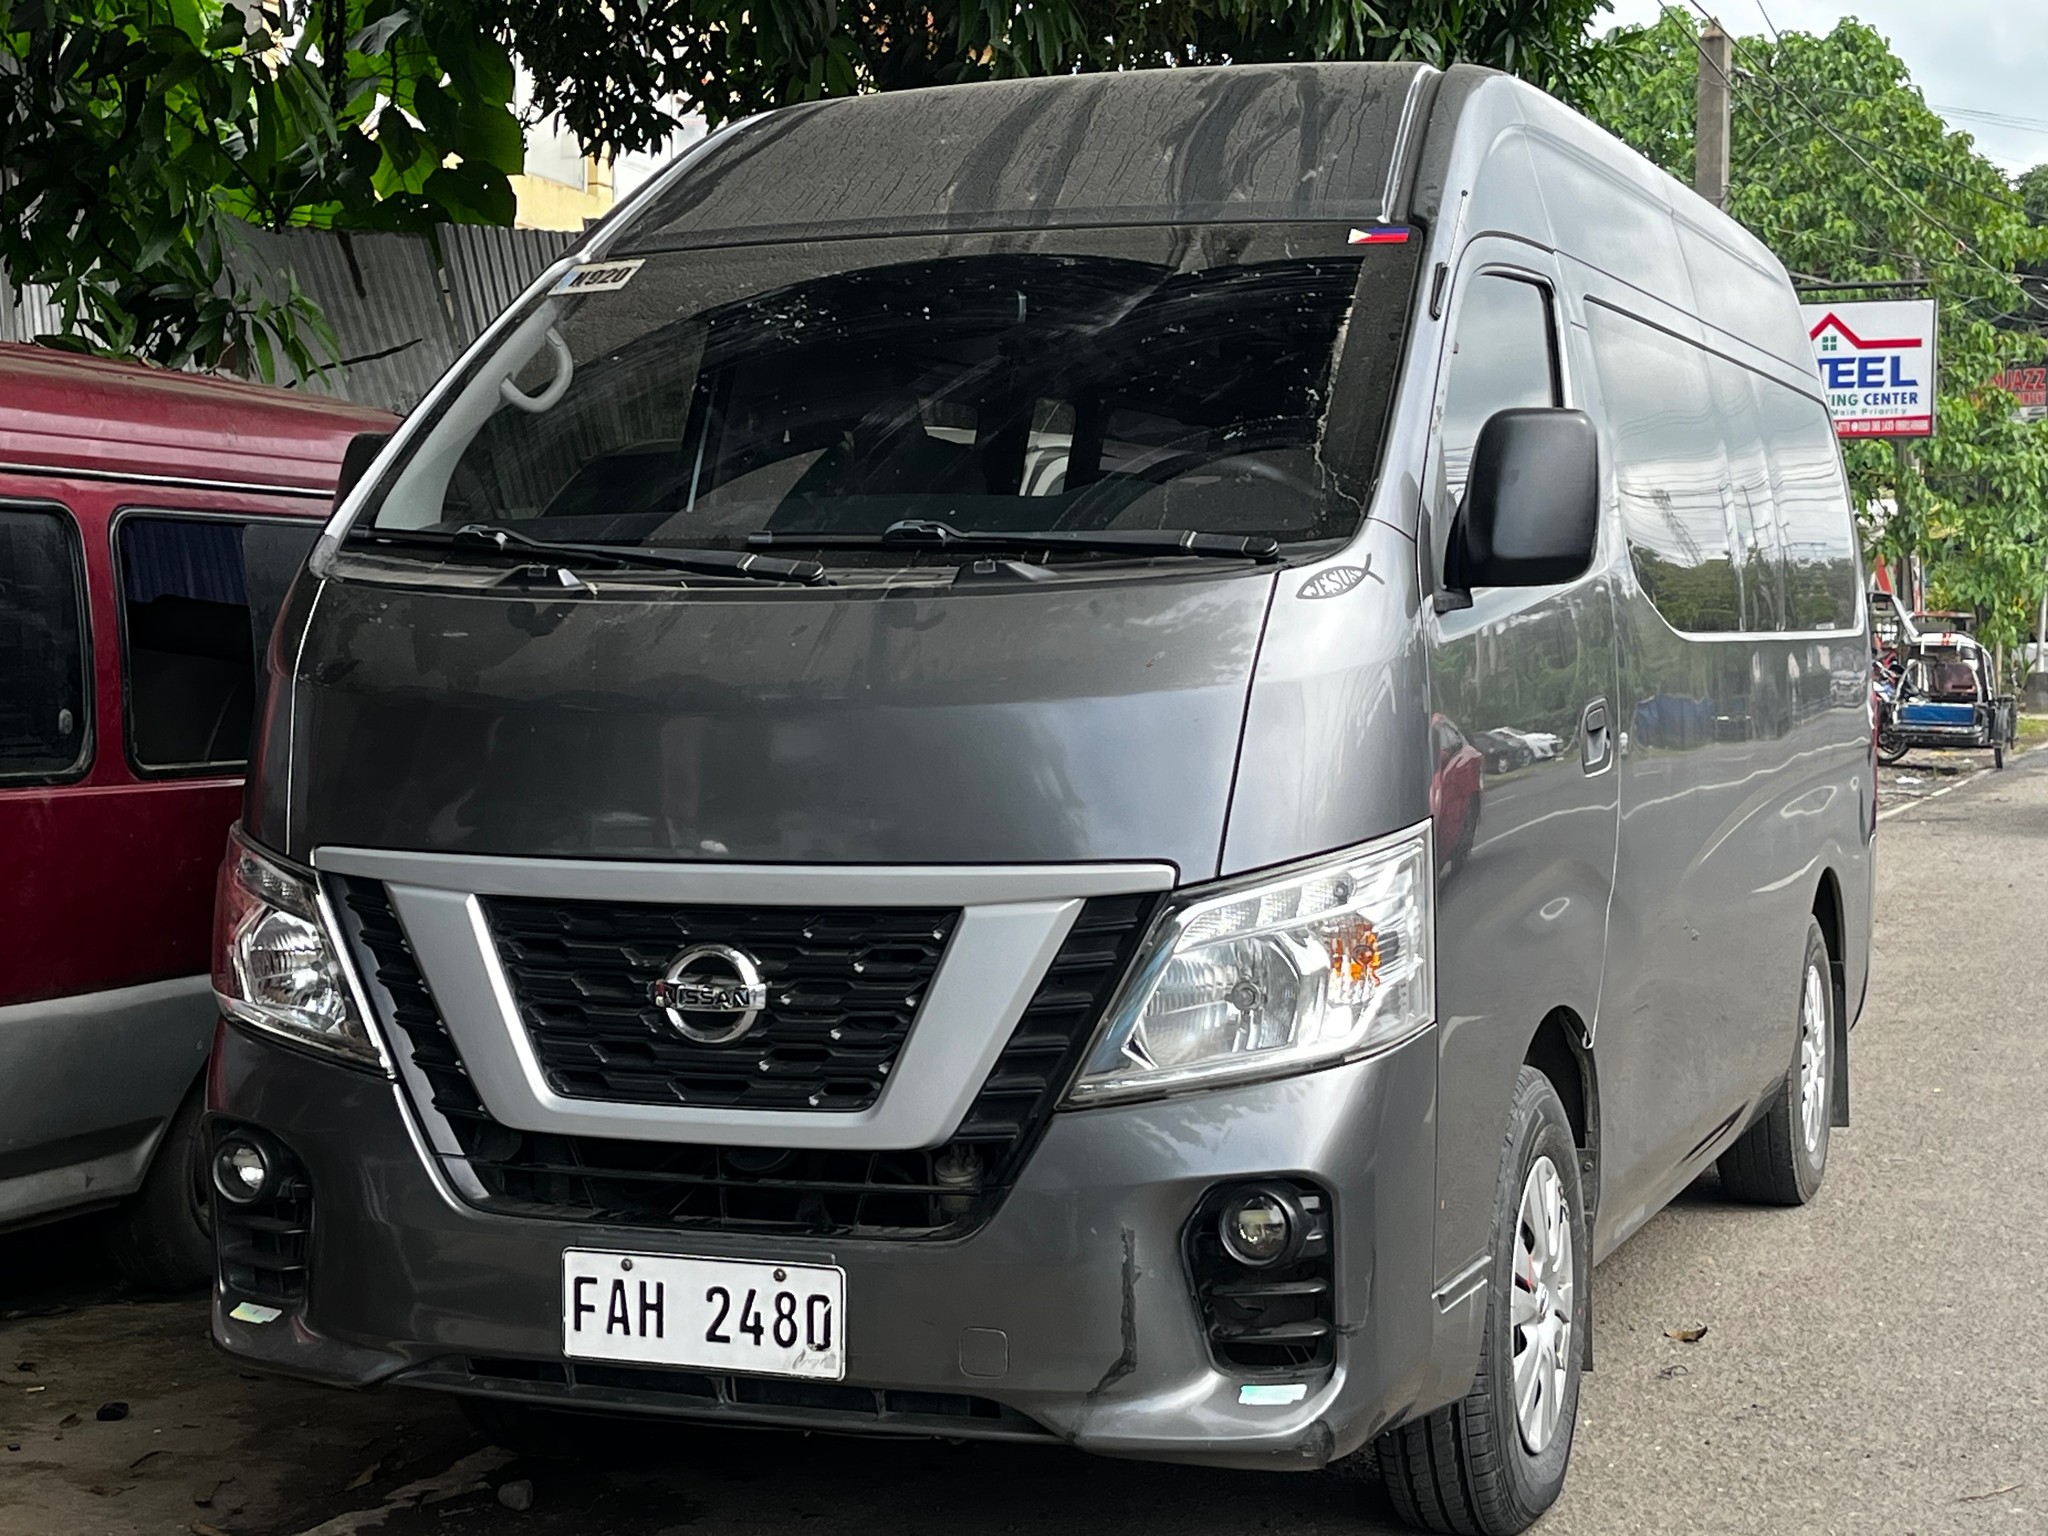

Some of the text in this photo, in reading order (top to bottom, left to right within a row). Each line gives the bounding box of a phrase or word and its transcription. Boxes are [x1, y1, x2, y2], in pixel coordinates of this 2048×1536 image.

[1827, 392, 1918, 407] ING CENTER
[1861, 407, 1908, 416] Priority
[1310, 568, 1362, 597] JESUS
[664, 984, 751, 1010] NISSAN
[573, 1276, 833, 1351] FAH 2480
